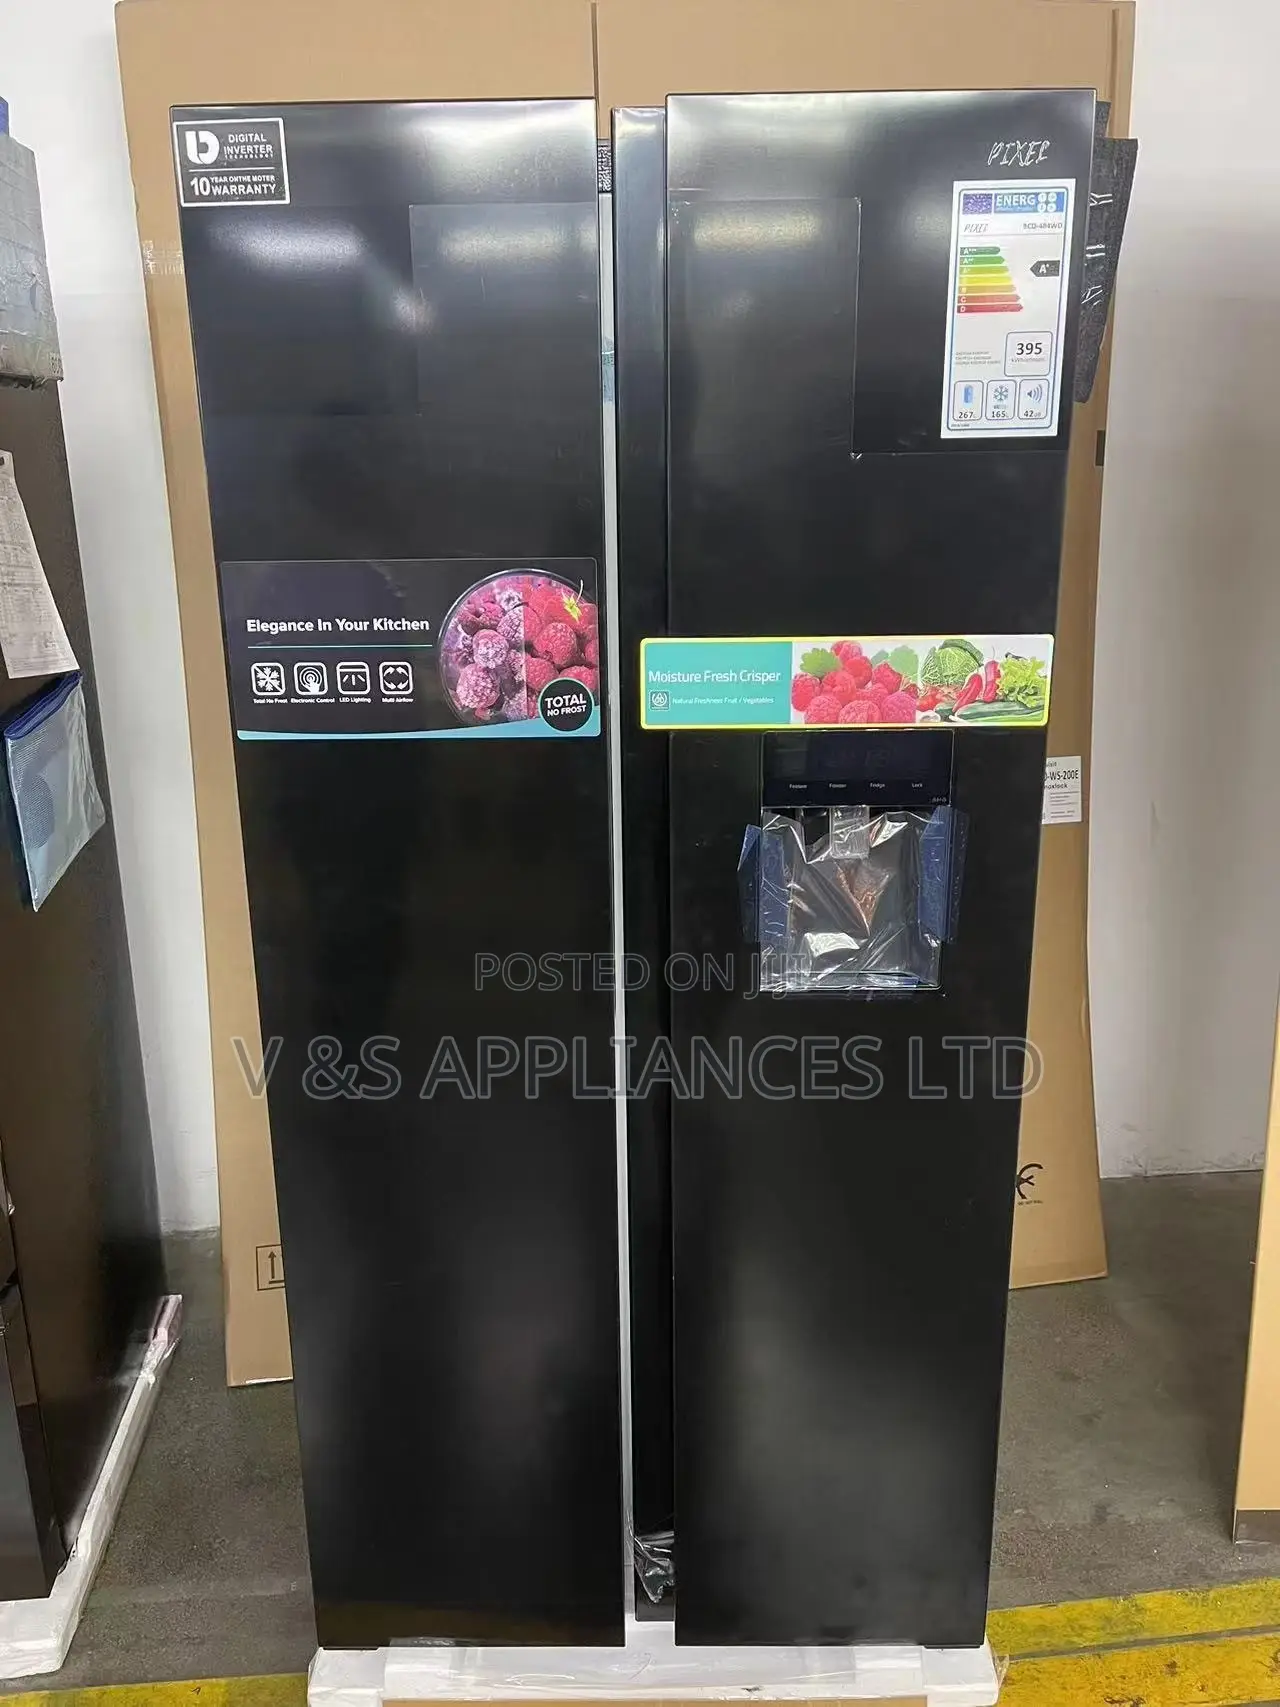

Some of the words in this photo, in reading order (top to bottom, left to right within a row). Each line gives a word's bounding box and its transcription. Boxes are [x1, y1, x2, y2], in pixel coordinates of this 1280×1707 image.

[228, 133, 267, 143] DIGITAL
[223, 144, 274, 154] INVERTER
[190, 176, 211, 197] 10
[210, 175, 229, 184] YEAR
[211, 183, 277, 196] WARRANTY
[995, 193, 1036, 207] ENERG
[1015, 341, 1044, 356] 395
[246, 618, 315, 635] Elegance
[317, 618, 332, 632] In
[335, 618, 370, 632] Your
[372, 617, 430, 632] Kitchen
[649, 670, 702, 684] Moisture
[703, 669, 738, 683] Fresh
[739, 669, 781, 685] Crisper
[544, 693, 588, 709] TOTAL
[547, 708, 560, 717] NO
[560, 704, 587, 715] FROST
